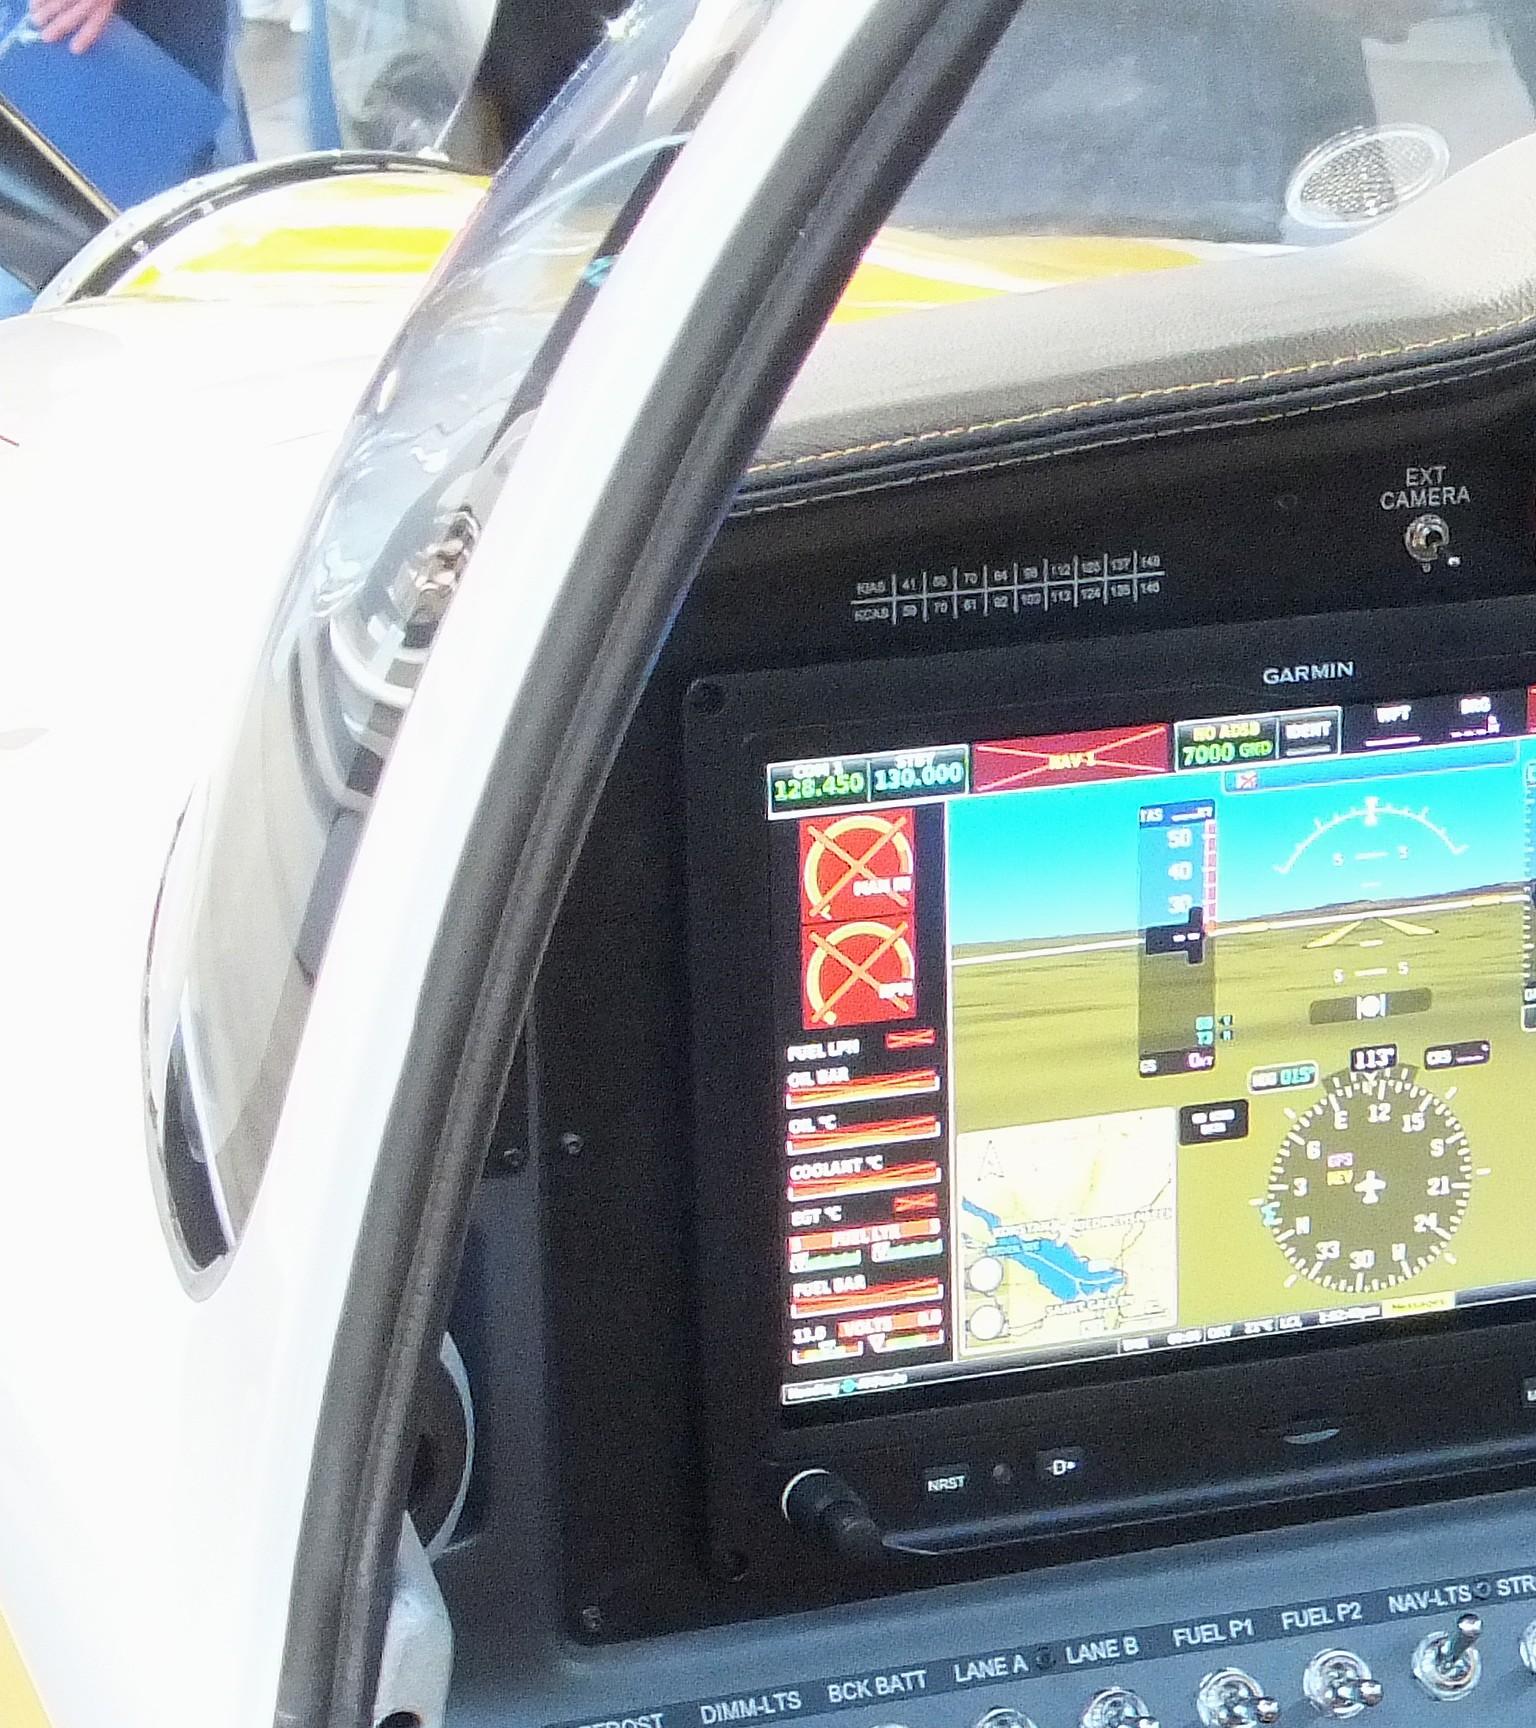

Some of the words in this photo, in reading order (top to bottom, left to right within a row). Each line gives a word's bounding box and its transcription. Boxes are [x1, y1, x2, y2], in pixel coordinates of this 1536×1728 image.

[1406, 466, 1447, 486] EXT
[1380, 484, 1471, 511] CAMERA
[1262, 661, 1354, 685] GARMIN
[774, 772, 865, 801] 128.450
[873, 761, 964, 790] 130.000
[1334, 1109, 1349, 1130] E
[1368, 1102, 1391, 1123] 12
[1401, 1111, 1426, 1133] 15
[1426, 1175, 1450, 1197] 21
[1413, 1212, 1440, 1233] 24
[1315, 1239, 1341, 1261] 33
[1350, 1249, 1375, 1271] 30
[926, 1474, 965, 1492] NRST
[1387, 1583, 1473, 1614] NAV-LTS
[1280, 1607, 1334, 1632] FUEL
[1336, 1601, 1363, 1624] P2
[1172, 1624, 1227, 1650] FUEL
[1230, 1617, 1255, 1641] P1
[1065, 1640, 1120, 1666] LANE
[1123, 1635, 1139, 1657] B
[953, 1657, 1007, 1684] LANE
[1009, 1653, 1029, 1675] A
[827, 1677, 873, 1704] BCK
[876, 1669, 926, 1697] BATT
[700, 1689, 803, 1726] DIMM-LTS
